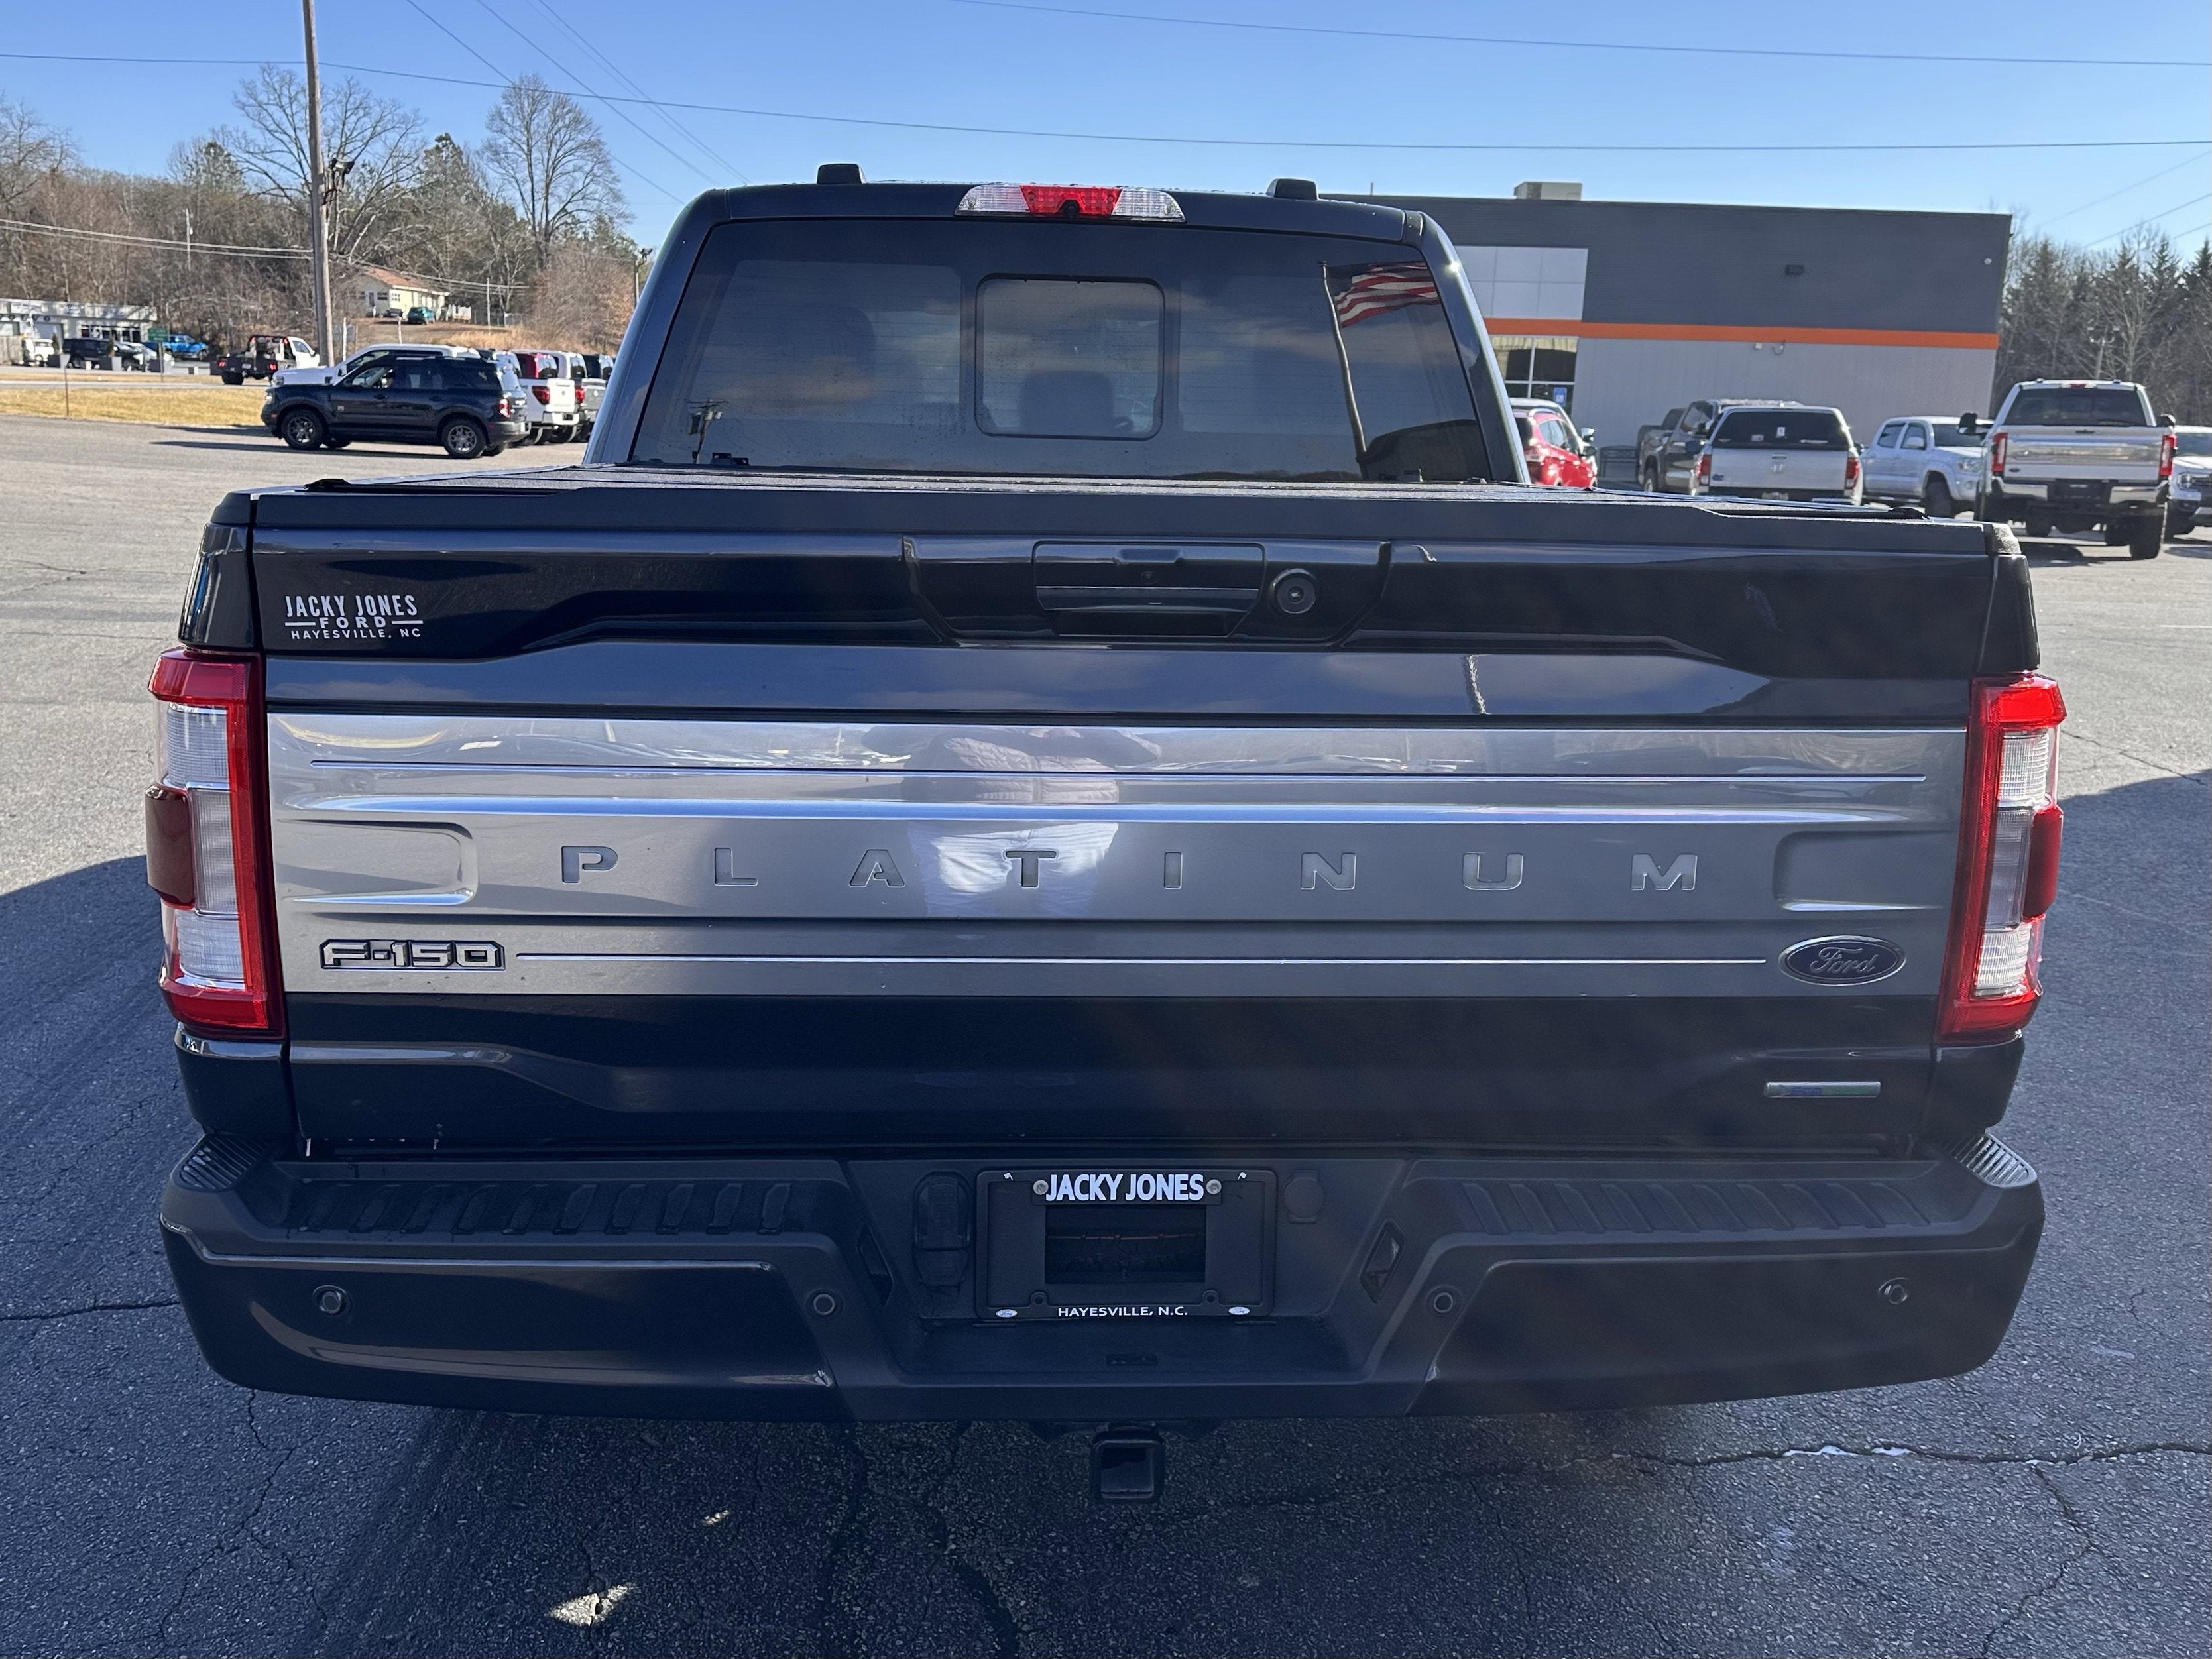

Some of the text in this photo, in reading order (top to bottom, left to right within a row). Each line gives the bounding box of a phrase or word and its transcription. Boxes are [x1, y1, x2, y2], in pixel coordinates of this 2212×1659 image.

[285, 595, 418, 617] JACKY JONES
[291, 628, 421, 640] HAYESVILLE, NC
[319, 616, 386, 629] FORD
[560, 845, 1699, 891] PLATINUM
[321, 939, 505, 970] F-150
[1810, 946, 1879, 974] Ford
[1046, 1173, 1204, 1202] JACKY JONES
[1057, 1306, 1188, 1317] HAYESVILLE, N.C.
